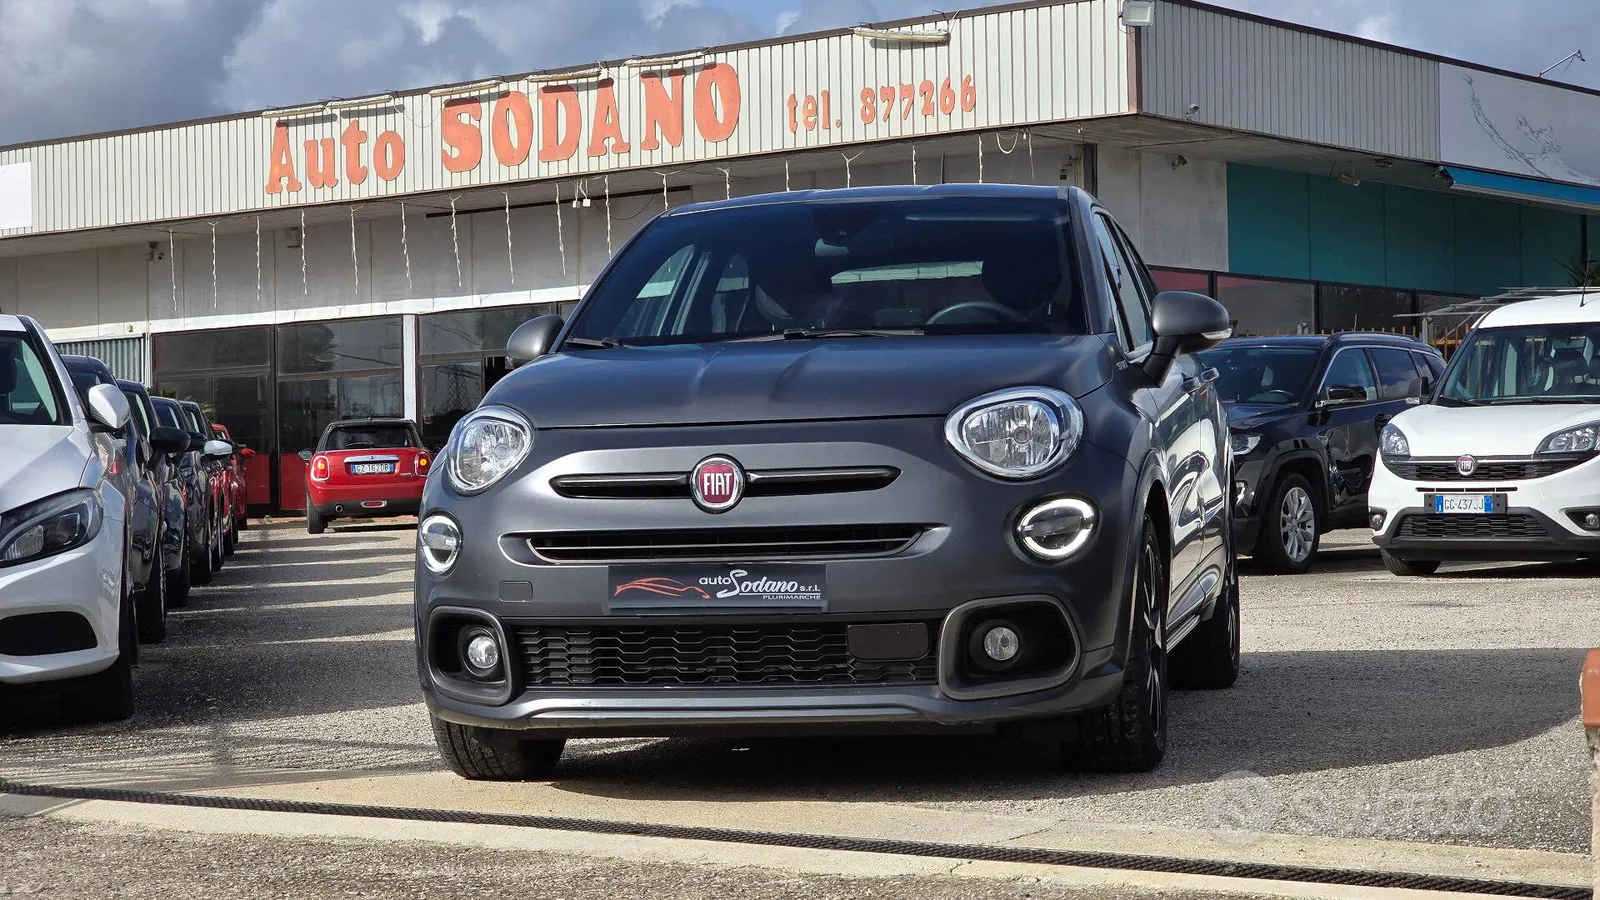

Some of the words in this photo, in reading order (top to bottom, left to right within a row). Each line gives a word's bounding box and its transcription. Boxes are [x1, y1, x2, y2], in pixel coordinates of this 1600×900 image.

[787, 90, 841, 134] tel.
[860, 74, 976, 125] 877266
[265, 119, 406, 195] Auto
[441, 62, 741, 173] SODANO
[703, 472, 732, 496] FIAT
[699, 576, 732, 585] auto
[716, 569, 798, 598] Sodano
[799, 584, 821, 592] s.r.l.
